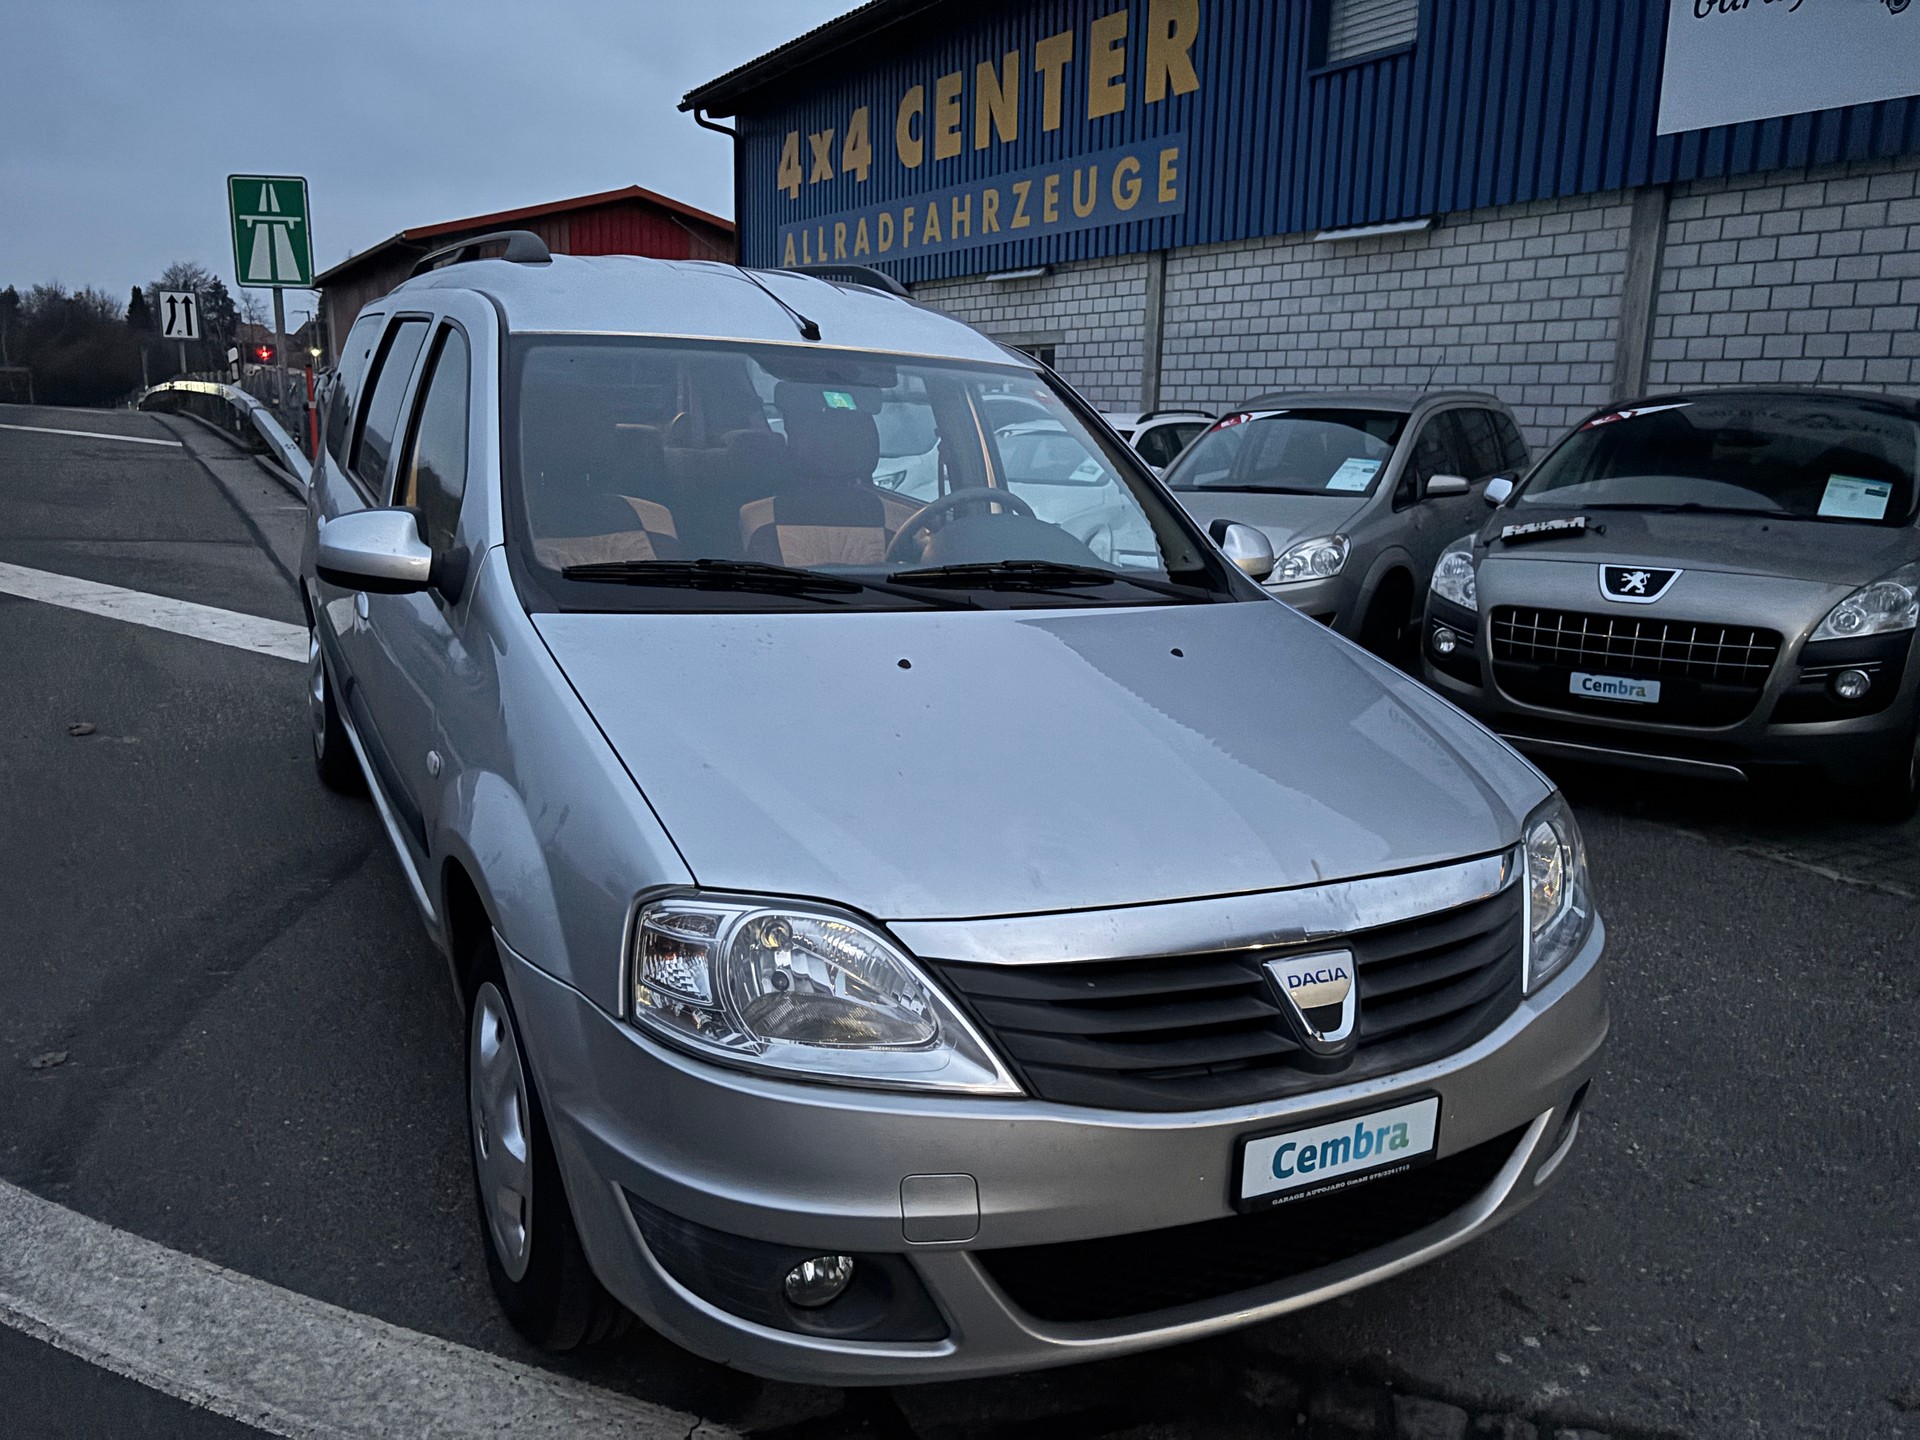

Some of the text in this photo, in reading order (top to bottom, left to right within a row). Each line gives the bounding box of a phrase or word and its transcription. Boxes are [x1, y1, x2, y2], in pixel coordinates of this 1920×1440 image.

[778, 0, 1200, 200] 4x4 CENTER
[783, 148, 1179, 268] ALLRADFAHRZEUGE
[1582, 677, 1646, 697] Cembra
[1287, 967, 1348, 989] DACIA
[1272, 1122, 1409, 1180] Cembra
[1272, 1192, 1305, 1205] GARAGE
[1347, 1175, 1369, 1186] GmbH
